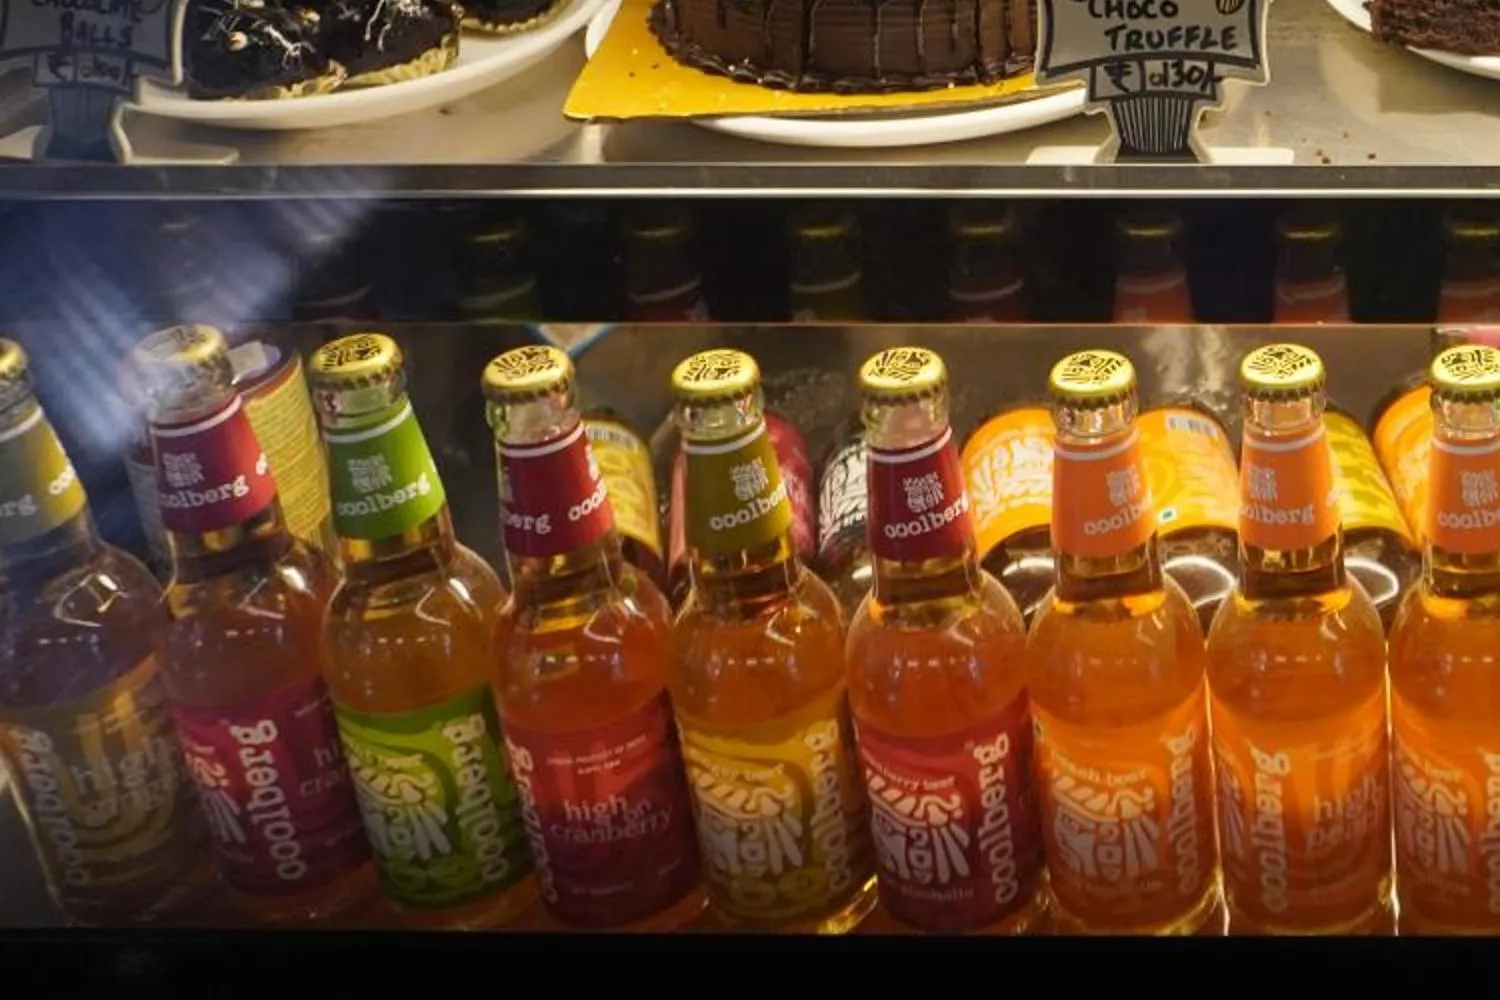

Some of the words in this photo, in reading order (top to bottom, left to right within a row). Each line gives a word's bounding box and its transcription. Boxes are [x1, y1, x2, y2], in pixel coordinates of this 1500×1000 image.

[1104, 24, 1239, 51] TRUFFLE
[230, 718, 308, 881] coolberg
[440, 711, 509, 883] coolberg
[550, 803, 674, 845] cranberry
[564, 793, 628, 824] high
[804, 719, 851, 891] coolberg
[973, 731, 1018, 905] coolberg
[1249, 744, 1293, 914] coolberg
